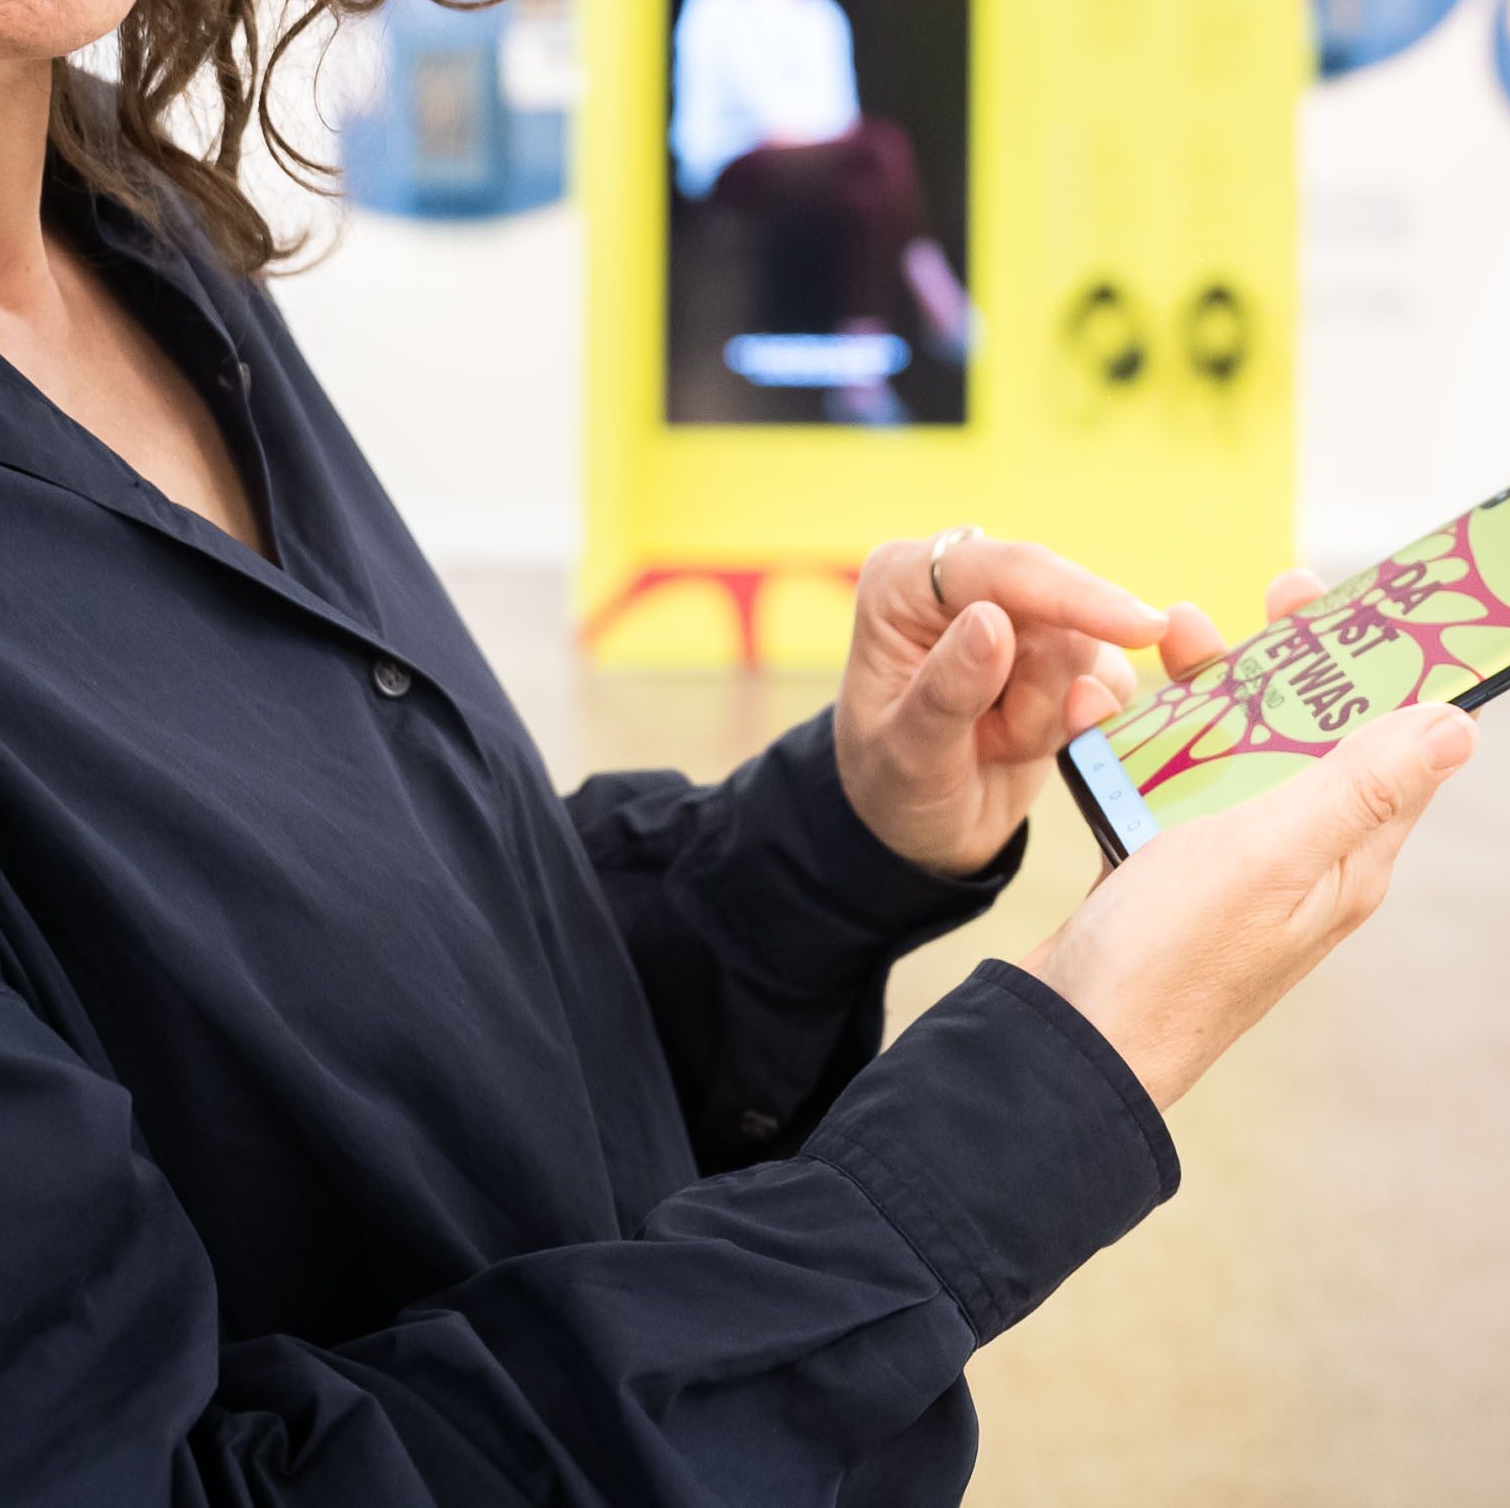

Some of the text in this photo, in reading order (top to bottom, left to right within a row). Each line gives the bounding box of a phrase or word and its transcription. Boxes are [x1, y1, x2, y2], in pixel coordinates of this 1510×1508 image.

[1378, 560, 1441, 615] DA
[1326, 604, 1400, 658] IST
[1265, 628, 1370, 732] ETWAS
